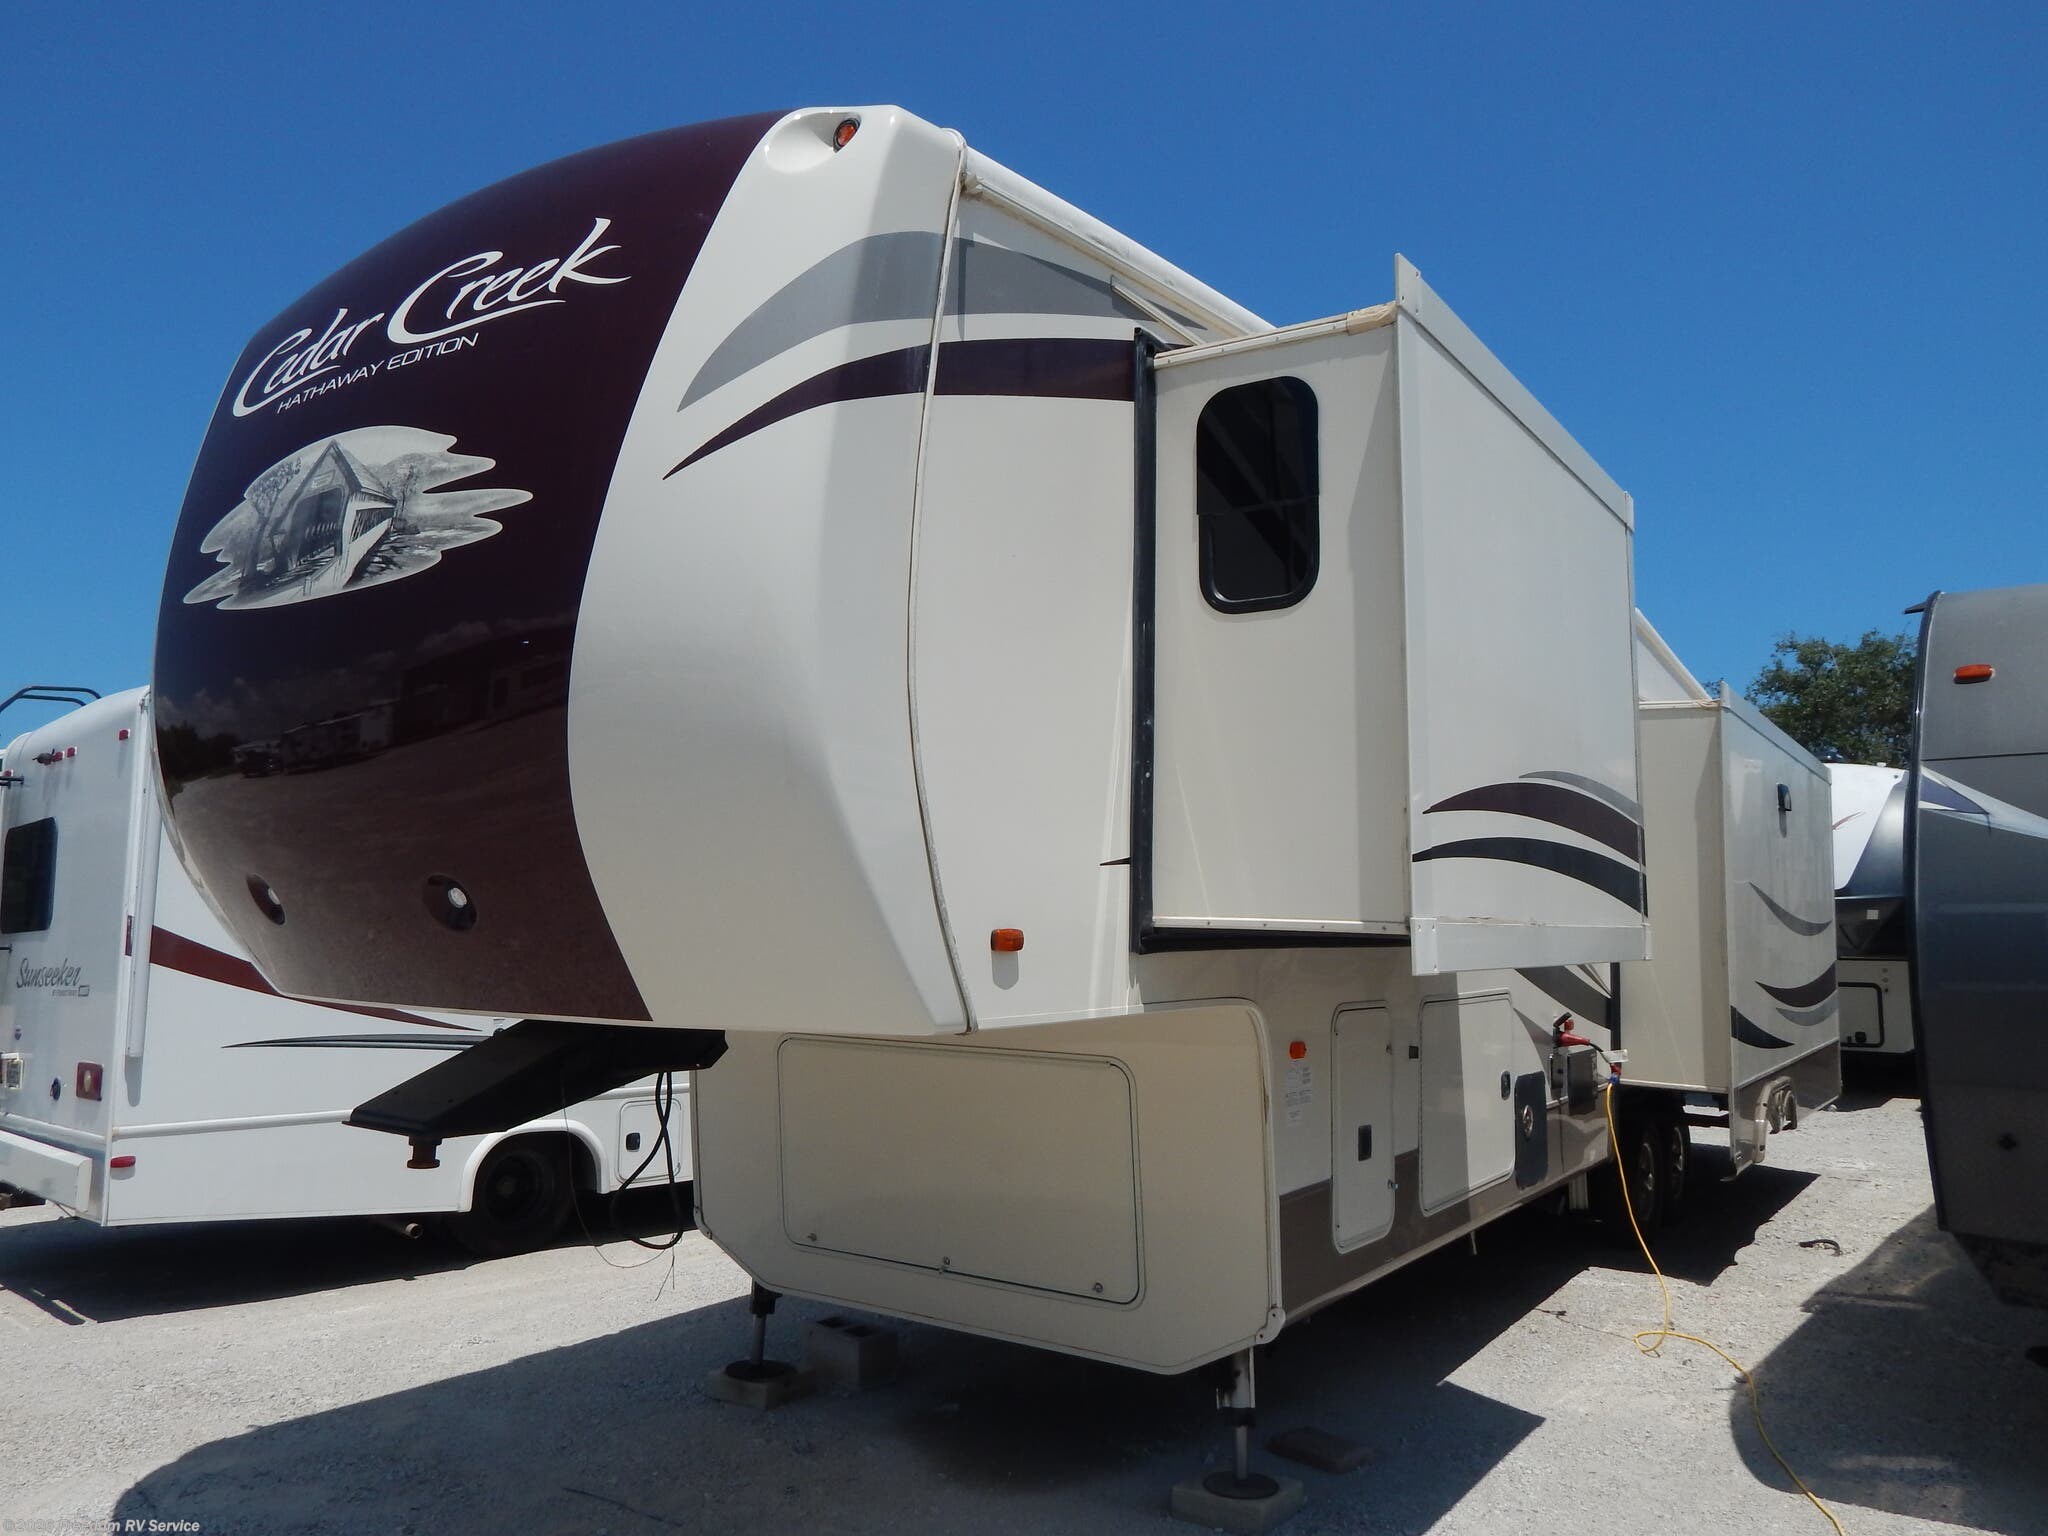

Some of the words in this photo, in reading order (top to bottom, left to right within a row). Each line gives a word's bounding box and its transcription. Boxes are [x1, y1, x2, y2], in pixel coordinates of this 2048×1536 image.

[232, 308, 384, 417] Cedar
[387, 217, 632, 344] Creek
[277, 361, 384, 414] HATHAWAY
[387, 333, 479, 370] EDITION
[16, 957, 82, 988] Sunseeker
